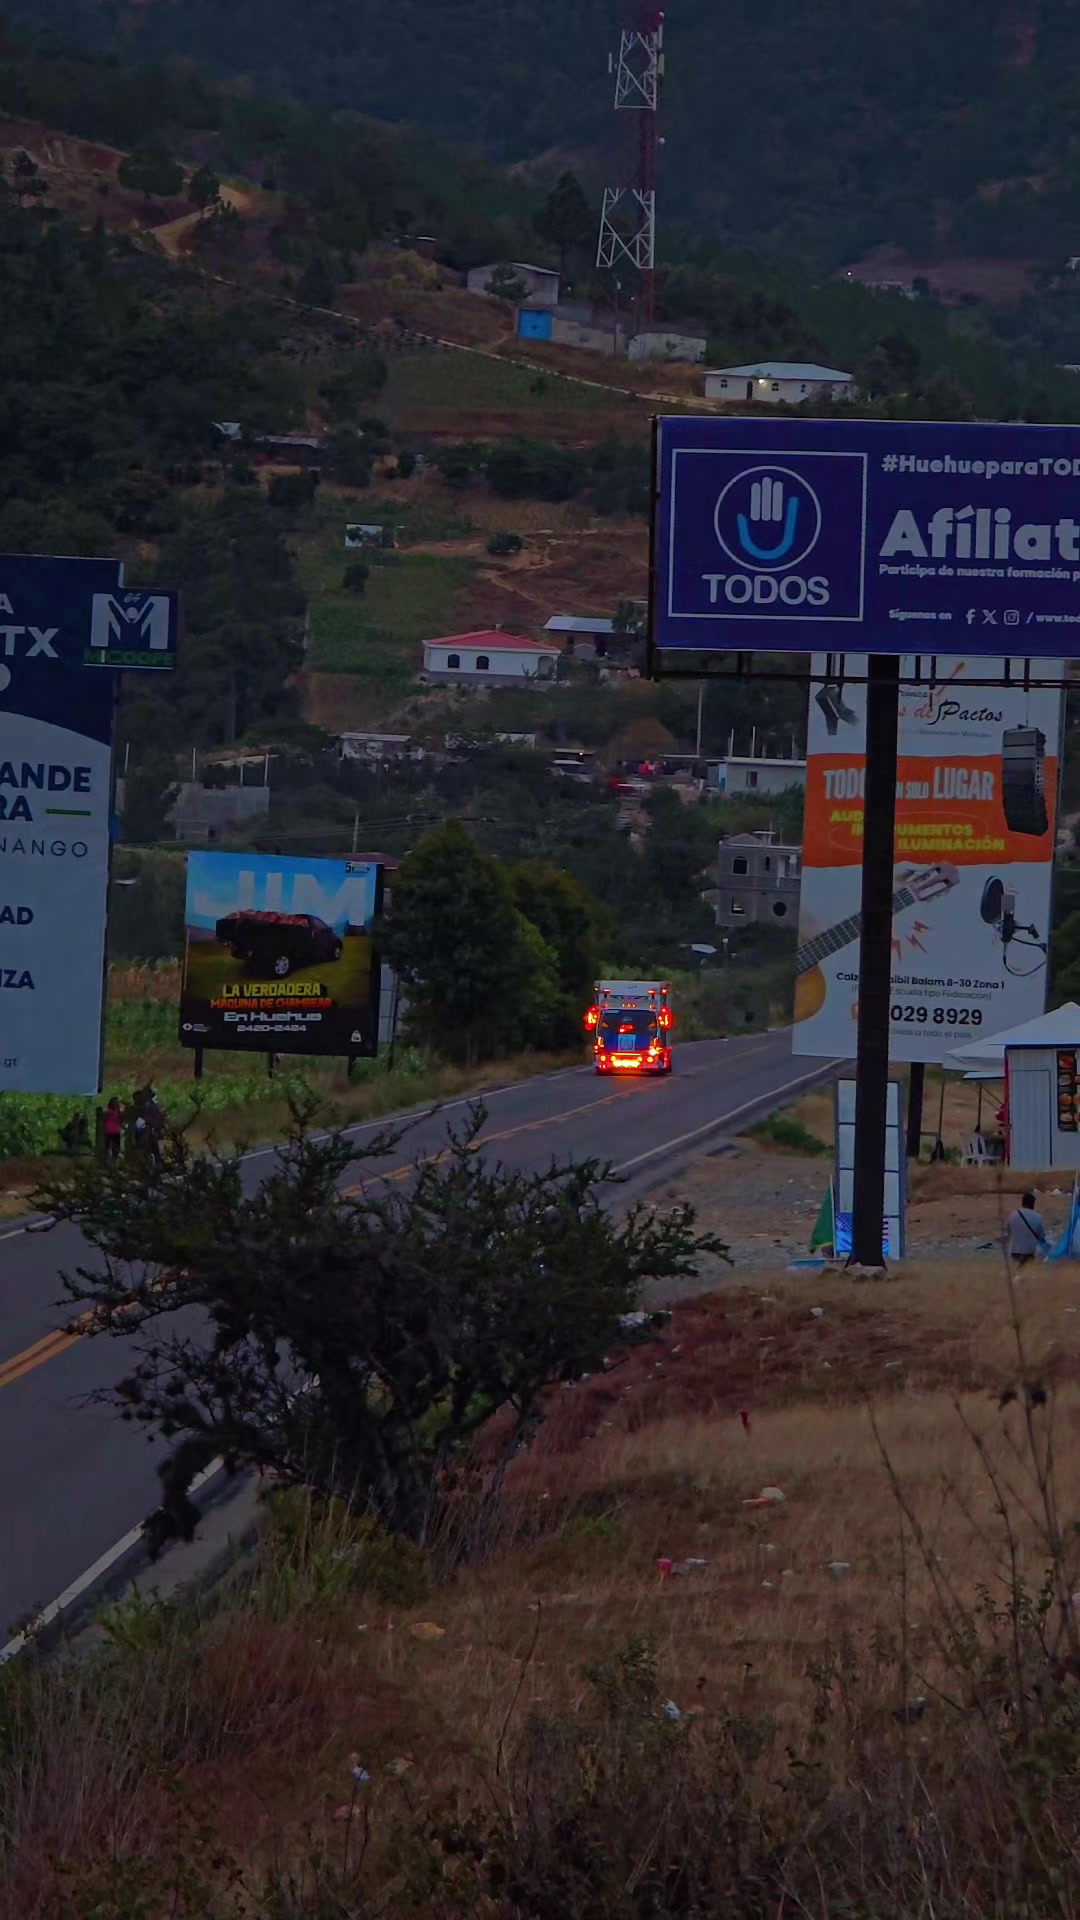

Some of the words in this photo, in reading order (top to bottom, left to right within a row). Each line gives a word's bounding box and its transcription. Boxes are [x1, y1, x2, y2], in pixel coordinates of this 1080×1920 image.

[879, 564, 936, 578] Participa
[938, 565, 954, 576] de
[957, 567, 1004, 577] nuestra
[1007, 567, 1070, 579] formación
[701, 574, 830, 606] TODOS
[938, 612, 952, 620] en
[927, 700, 1003, 726] Pactos
[905, 781, 929, 799] SOLO
[933, 766, 995, 801] LUGAR
[222, 983, 241, 998] LA
[243, 982, 321, 997] VERDADERA
[911, 976, 945, 987] Balam
[946, 978, 972, 988] 8-30
[972, 980, 999, 990] Zona
[223, 1011, 249, 1022] En
[250, 1010, 323, 1022] Huehue
[932, 1006, 983, 1026] 8929
